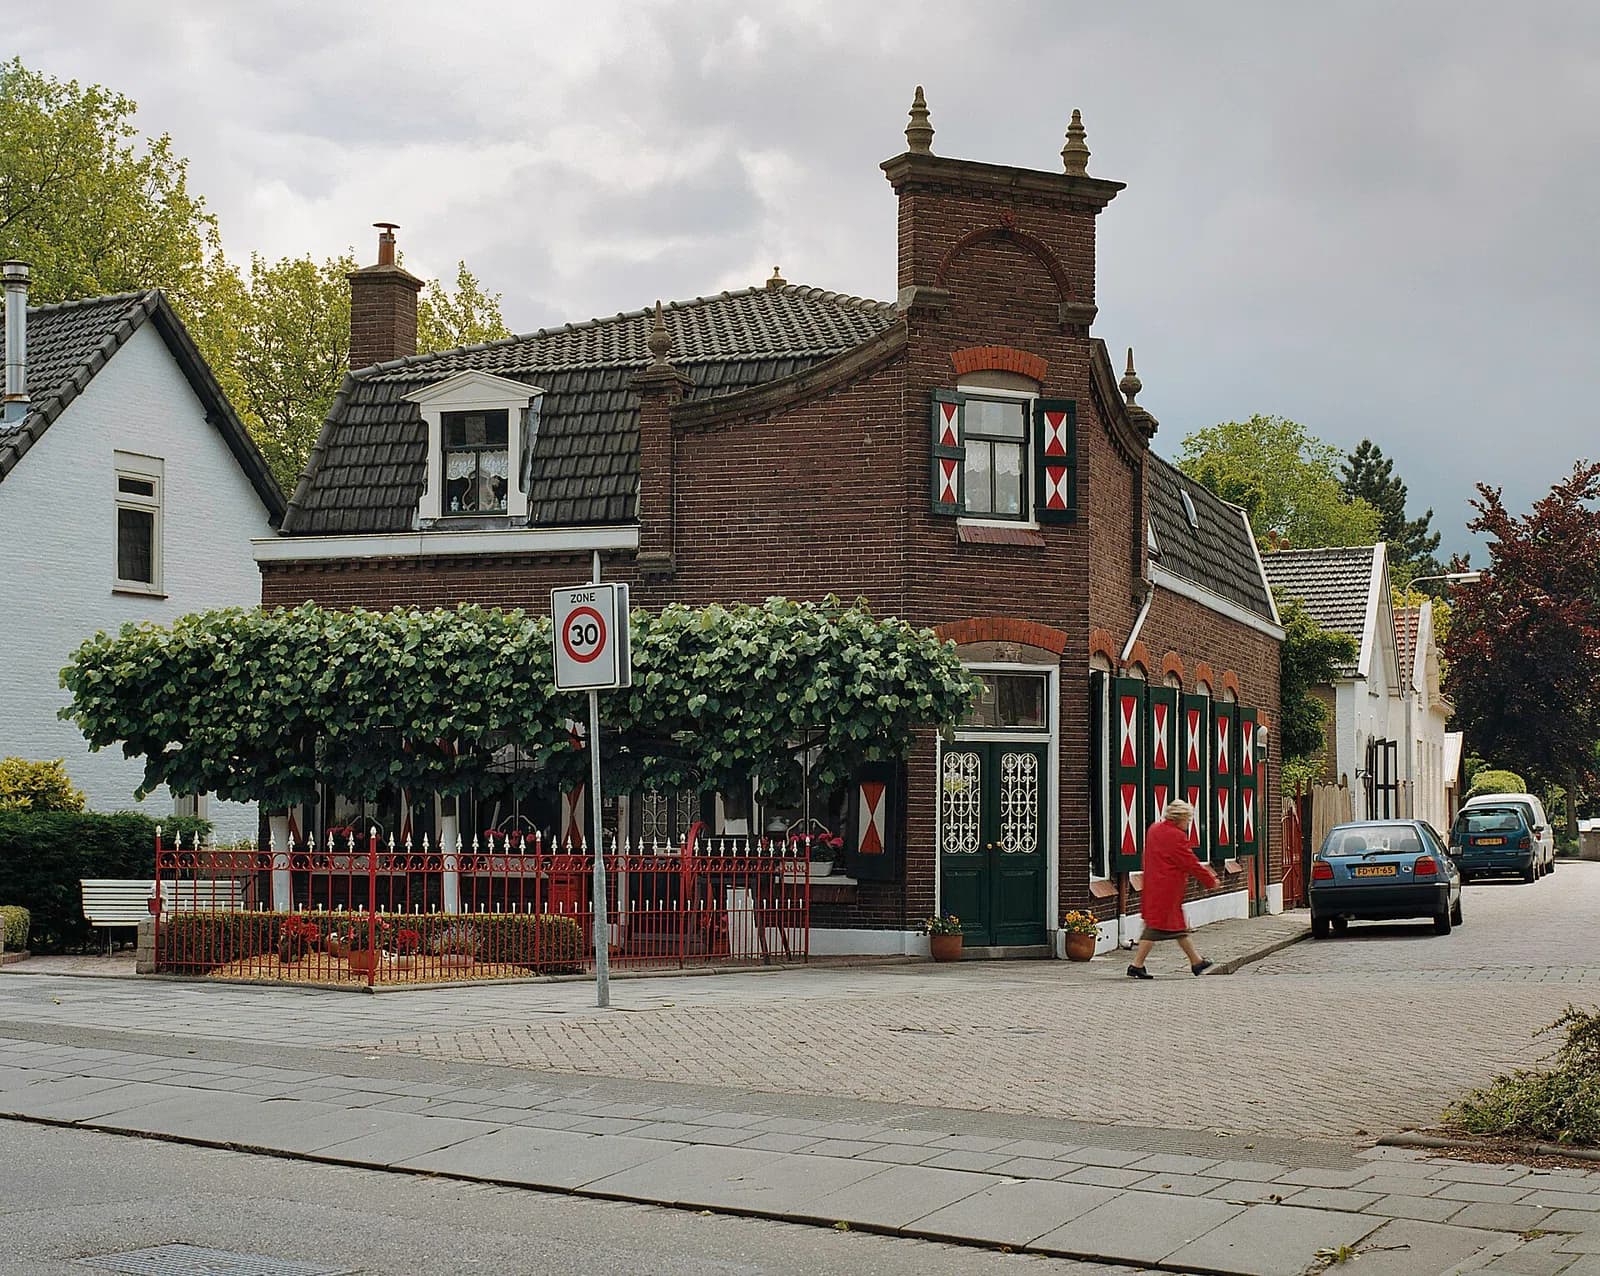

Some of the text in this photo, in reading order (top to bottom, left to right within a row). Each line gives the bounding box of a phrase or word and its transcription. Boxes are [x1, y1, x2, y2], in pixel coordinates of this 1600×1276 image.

[570, 592, 595, 603] ZONE
[571, 623, 598, 646] 30
[1357, 866, 1393, 875] FD-VT-65
